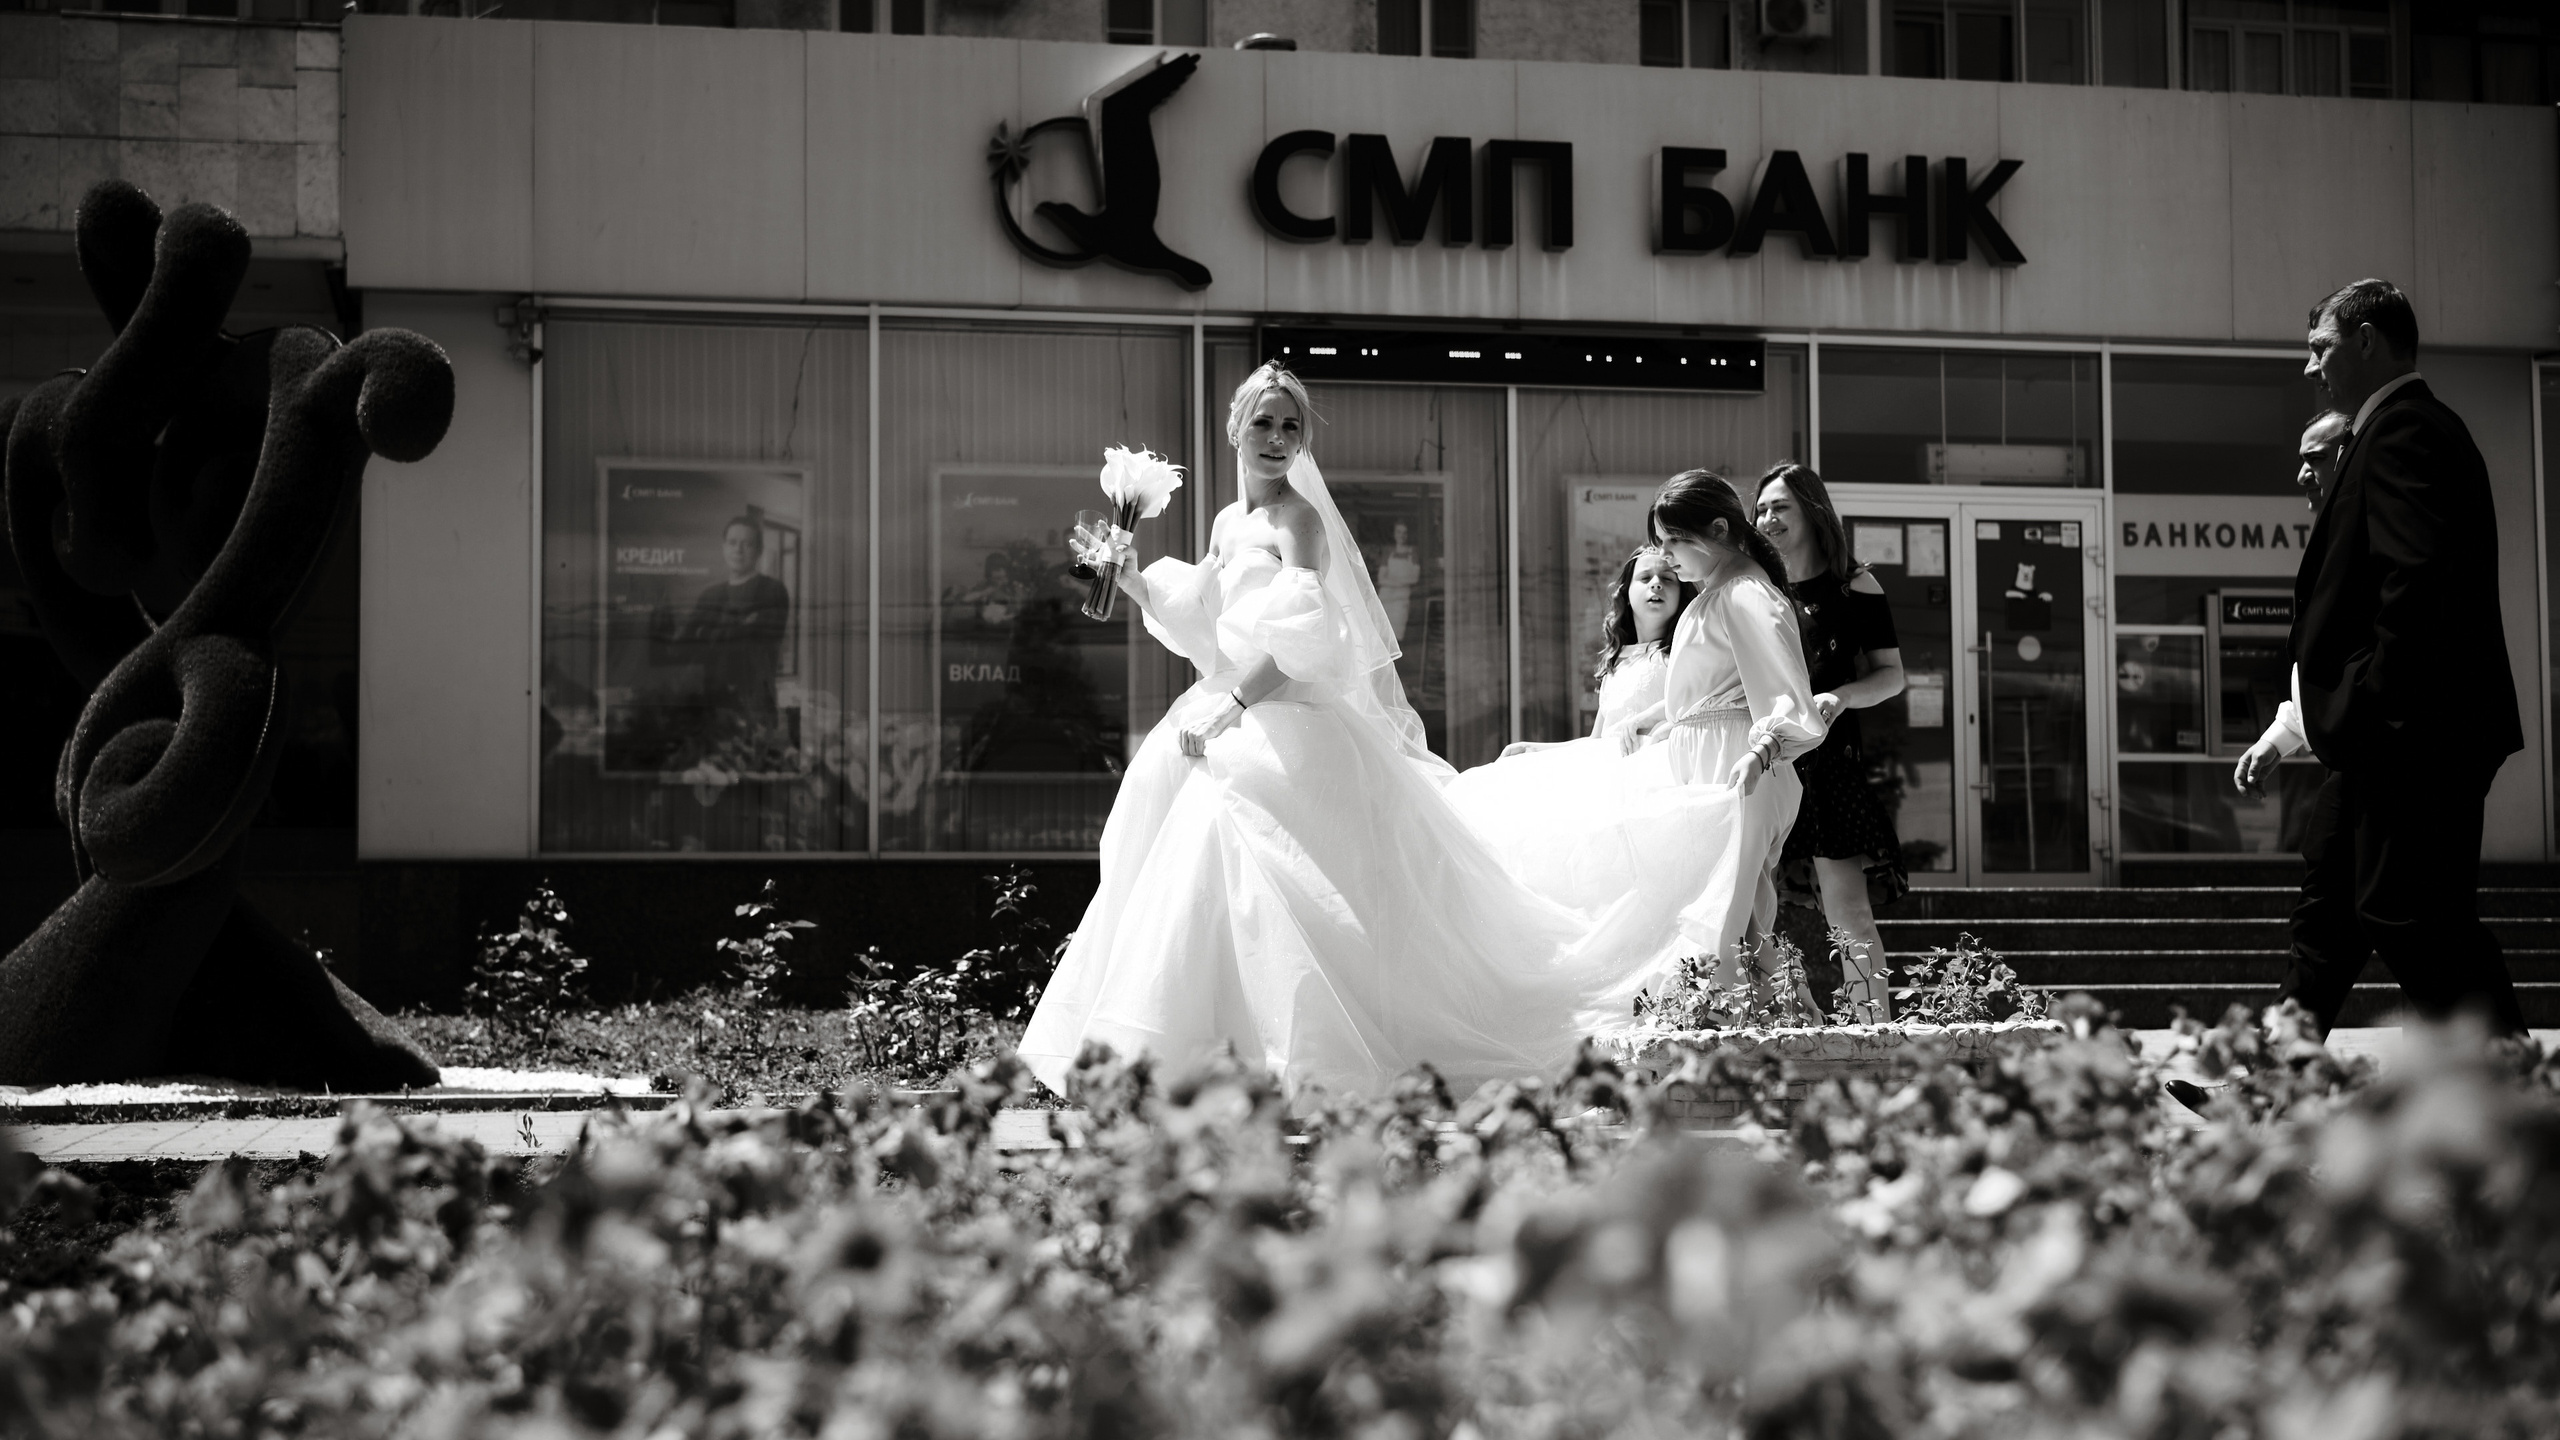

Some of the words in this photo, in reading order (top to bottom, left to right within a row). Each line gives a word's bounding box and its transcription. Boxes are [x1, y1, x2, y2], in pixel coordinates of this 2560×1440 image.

[1249, 129, 1576, 252] СМП
[1652, 145, 2027, 267] БАНК
[2122, 522, 2310, 549] БАНКОМАТ
[616, 548, 685, 564] КРЕДИТ
[2241, 606, 2263, 616] СМП
[2265, 606, 2290, 616] БАНК
[949, 664, 1021, 682] ВКЛАД
